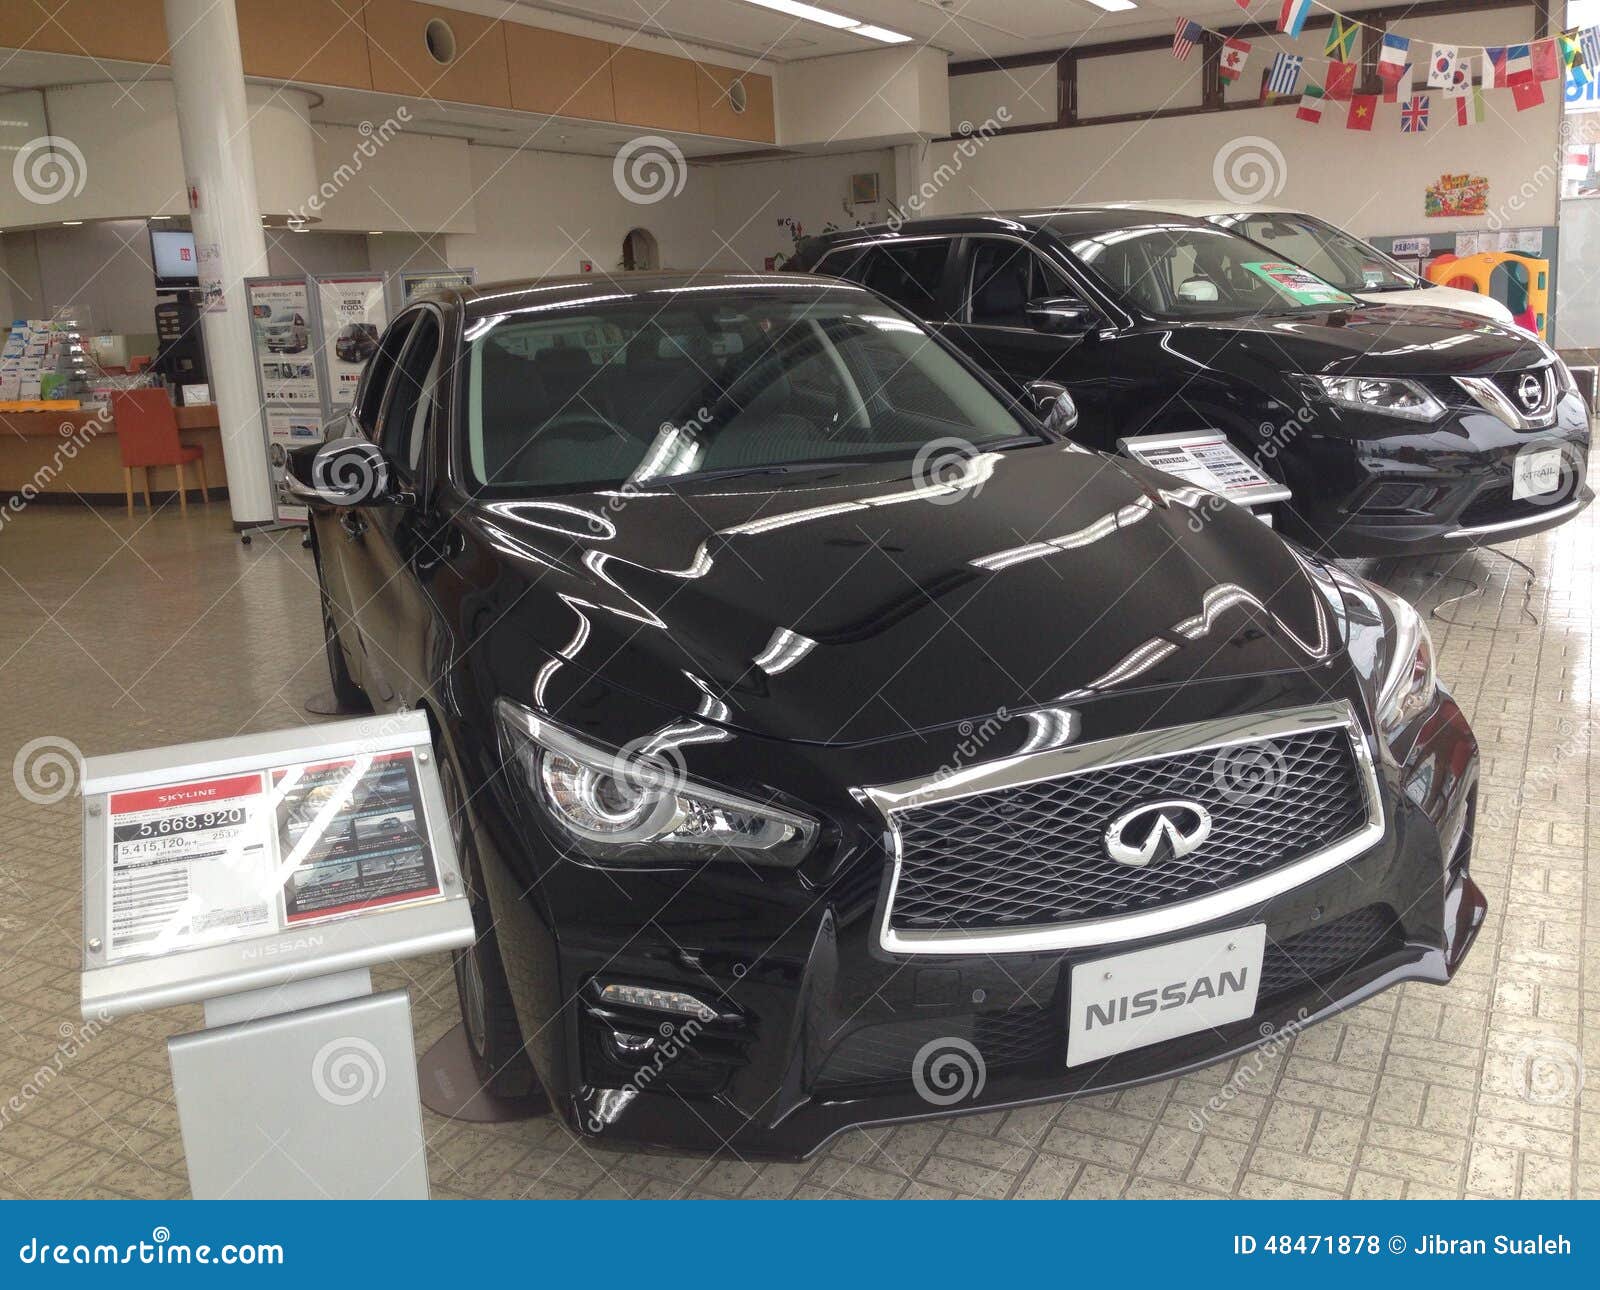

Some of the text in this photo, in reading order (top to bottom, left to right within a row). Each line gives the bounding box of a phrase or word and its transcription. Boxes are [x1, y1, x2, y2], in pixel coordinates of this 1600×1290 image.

[777, 218, 792, 226] WC
[1519, 467, 1556, 481] X-TRAIL
[158, 788, 217, 802] SKYLINE
[140, 808, 241, 836] 5,668,920
[122, 837, 184, 855] 5,415,120
[242, 935, 324, 960] NISSAN
[1085, 966, 1248, 1031] NISSAN
